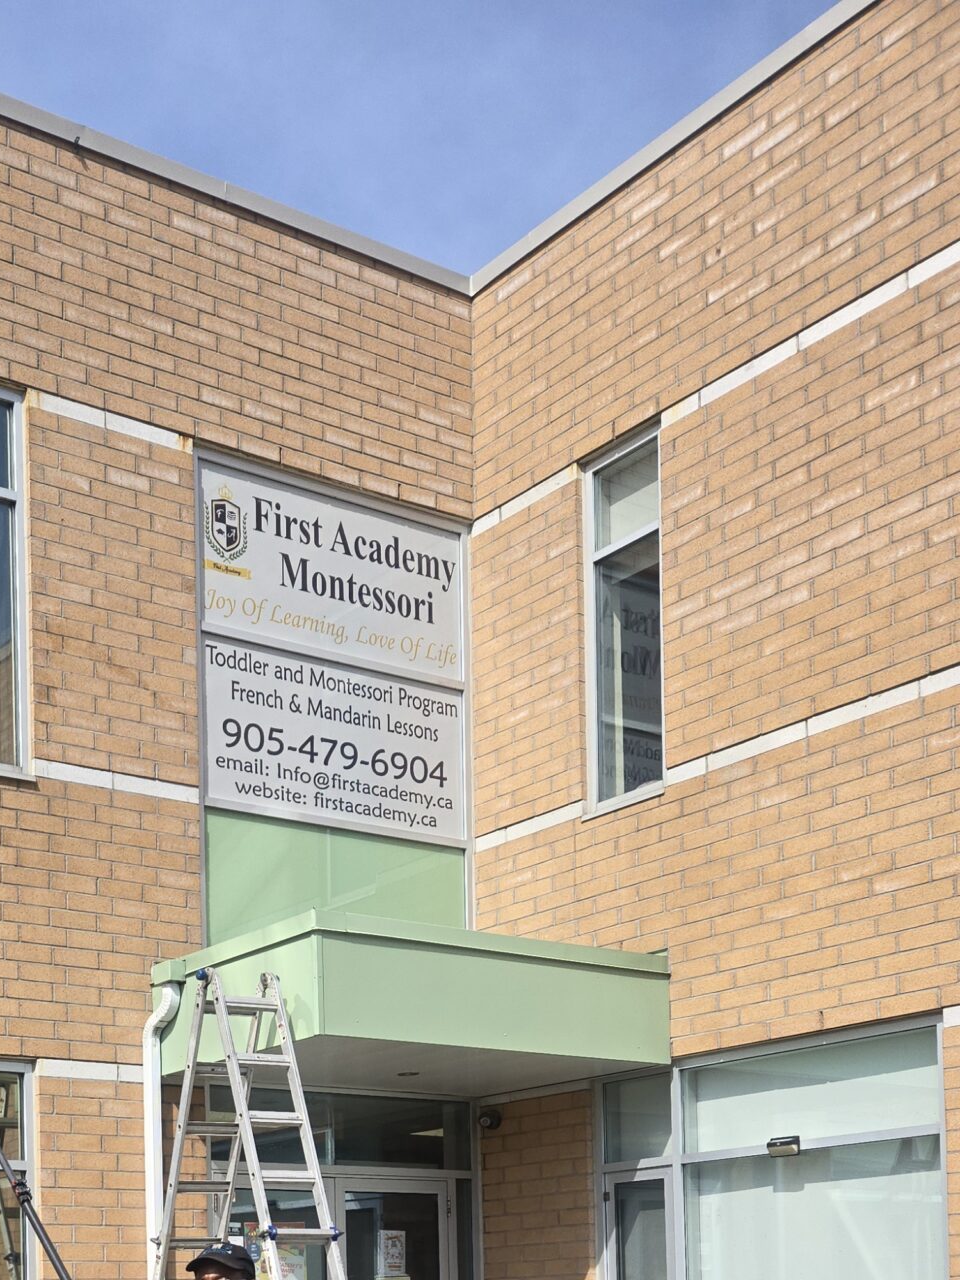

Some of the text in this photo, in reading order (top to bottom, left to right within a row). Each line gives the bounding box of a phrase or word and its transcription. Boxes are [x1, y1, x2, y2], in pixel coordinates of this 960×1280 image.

[252, 496, 456, 592] First Academy
[279, 552, 435, 624] Montessori
[204, 588, 457, 669] Joy Of Learning, Love Of Life
[205, 644, 458, 718] Toddler and Montessori Program
[231, 680, 439, 743] French & Mandarin Lessons
[215, 754, 454, 811] email: Info@firstacademy.ca
[221, 718, 448, 789] 905-479-6904
[235, 781, 438, 828] website: firstacademy.ca
